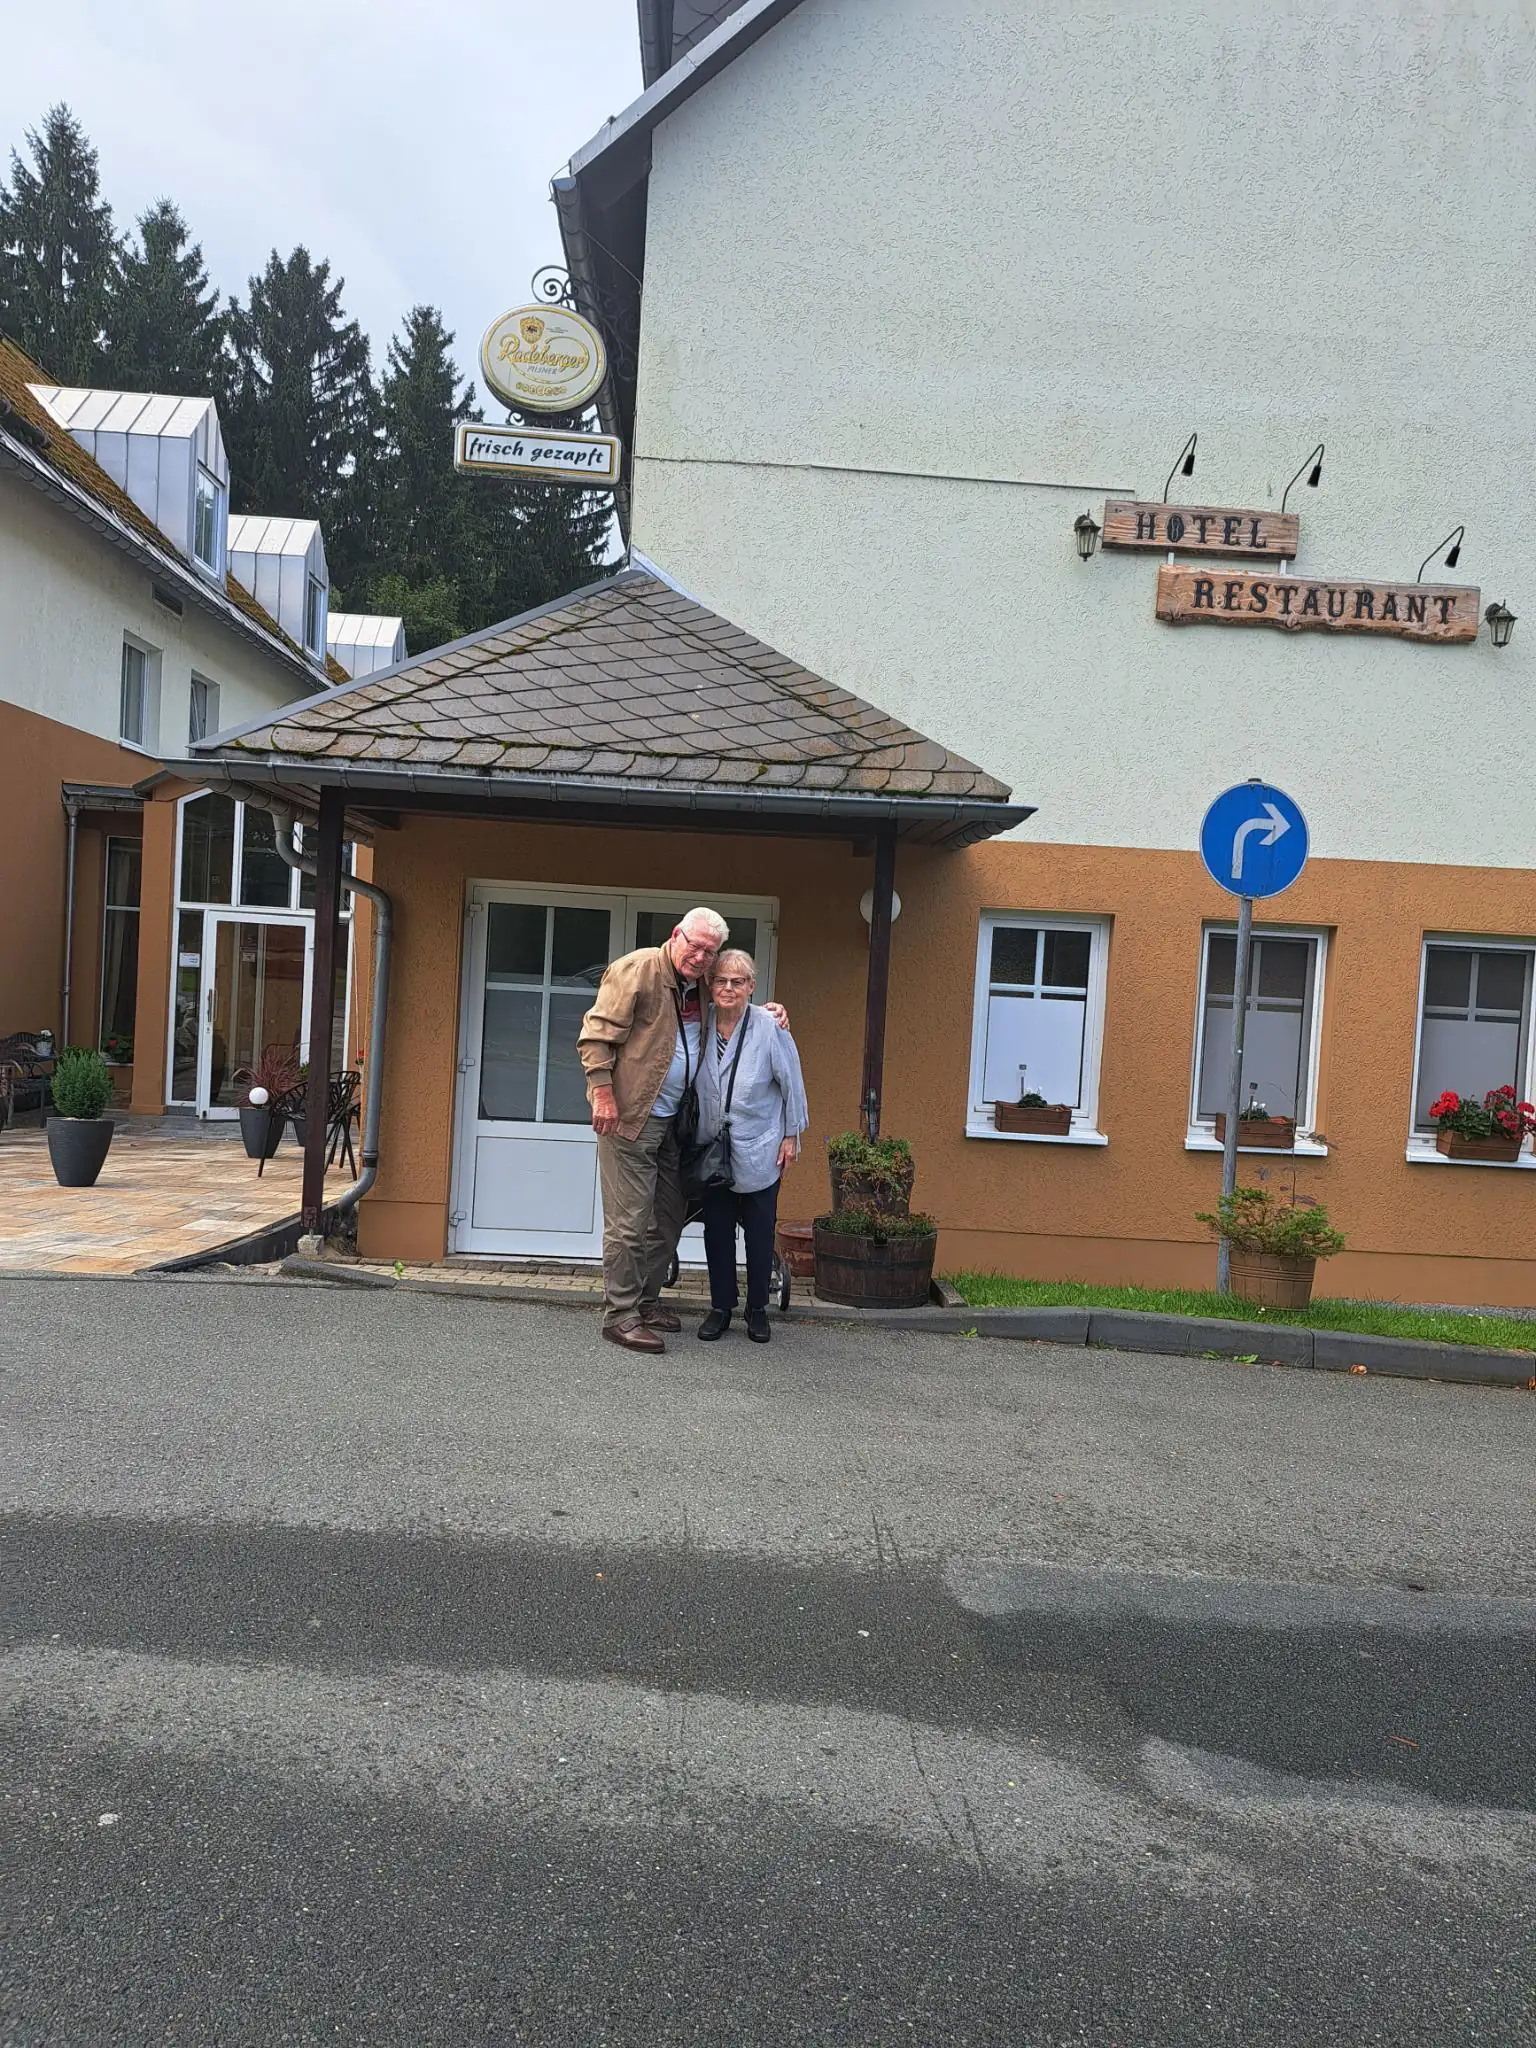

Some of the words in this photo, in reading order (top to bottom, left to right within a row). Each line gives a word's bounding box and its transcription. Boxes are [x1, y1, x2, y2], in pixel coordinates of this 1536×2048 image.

[497, 333, 589, 373] Radeberger
[526, 366, 558, 375] PILSNER
[469, 437, 524, 457] frisch
[530, 447, 604, 466] gezapft
[1135, 510, 1268, 548] HOTEL
[1192, 577, 1457, 625] RESTAURANT
